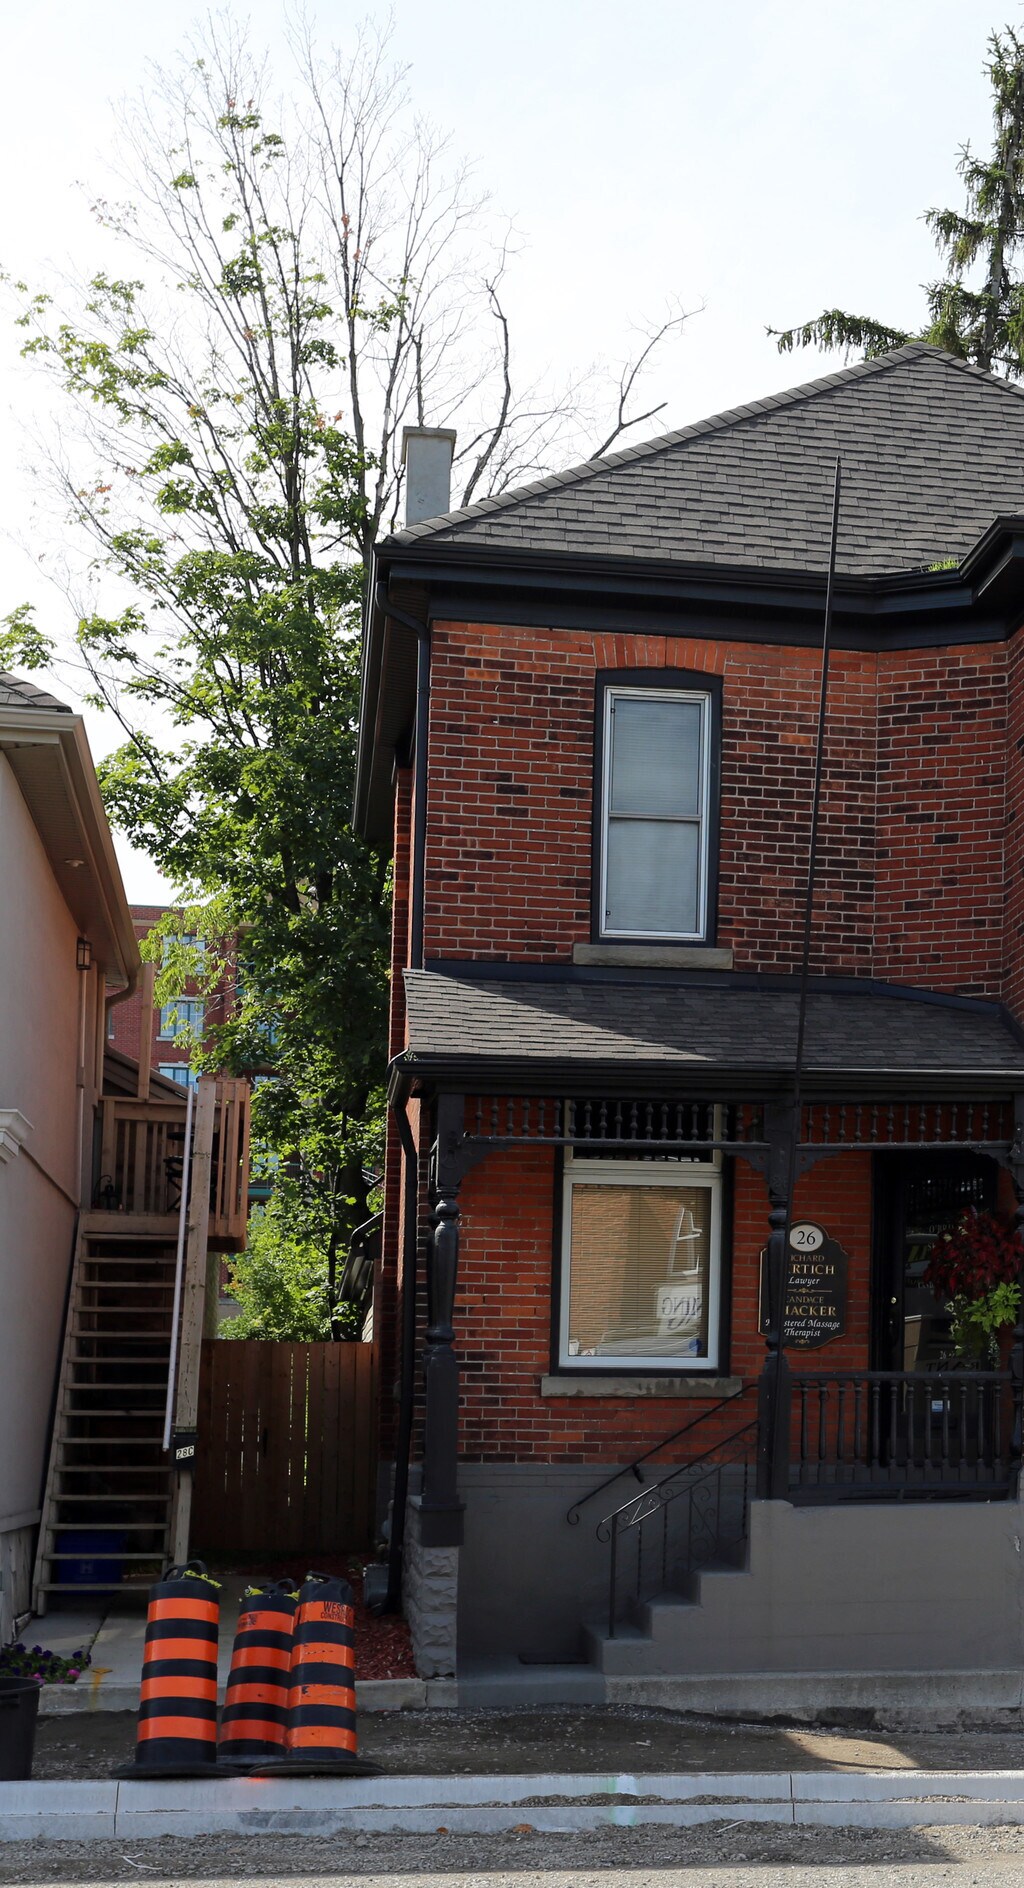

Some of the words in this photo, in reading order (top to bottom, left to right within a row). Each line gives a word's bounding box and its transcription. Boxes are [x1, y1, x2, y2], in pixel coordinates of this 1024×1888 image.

[797, 1231, 815, 1245] 26
[788, 1265, 834, 1275] RTICH
[788, 1277, 820, 1286] Lawyer
[808, 1320, 840, 1330] Massage
[784, 1328, 820, 1338] Therapist
